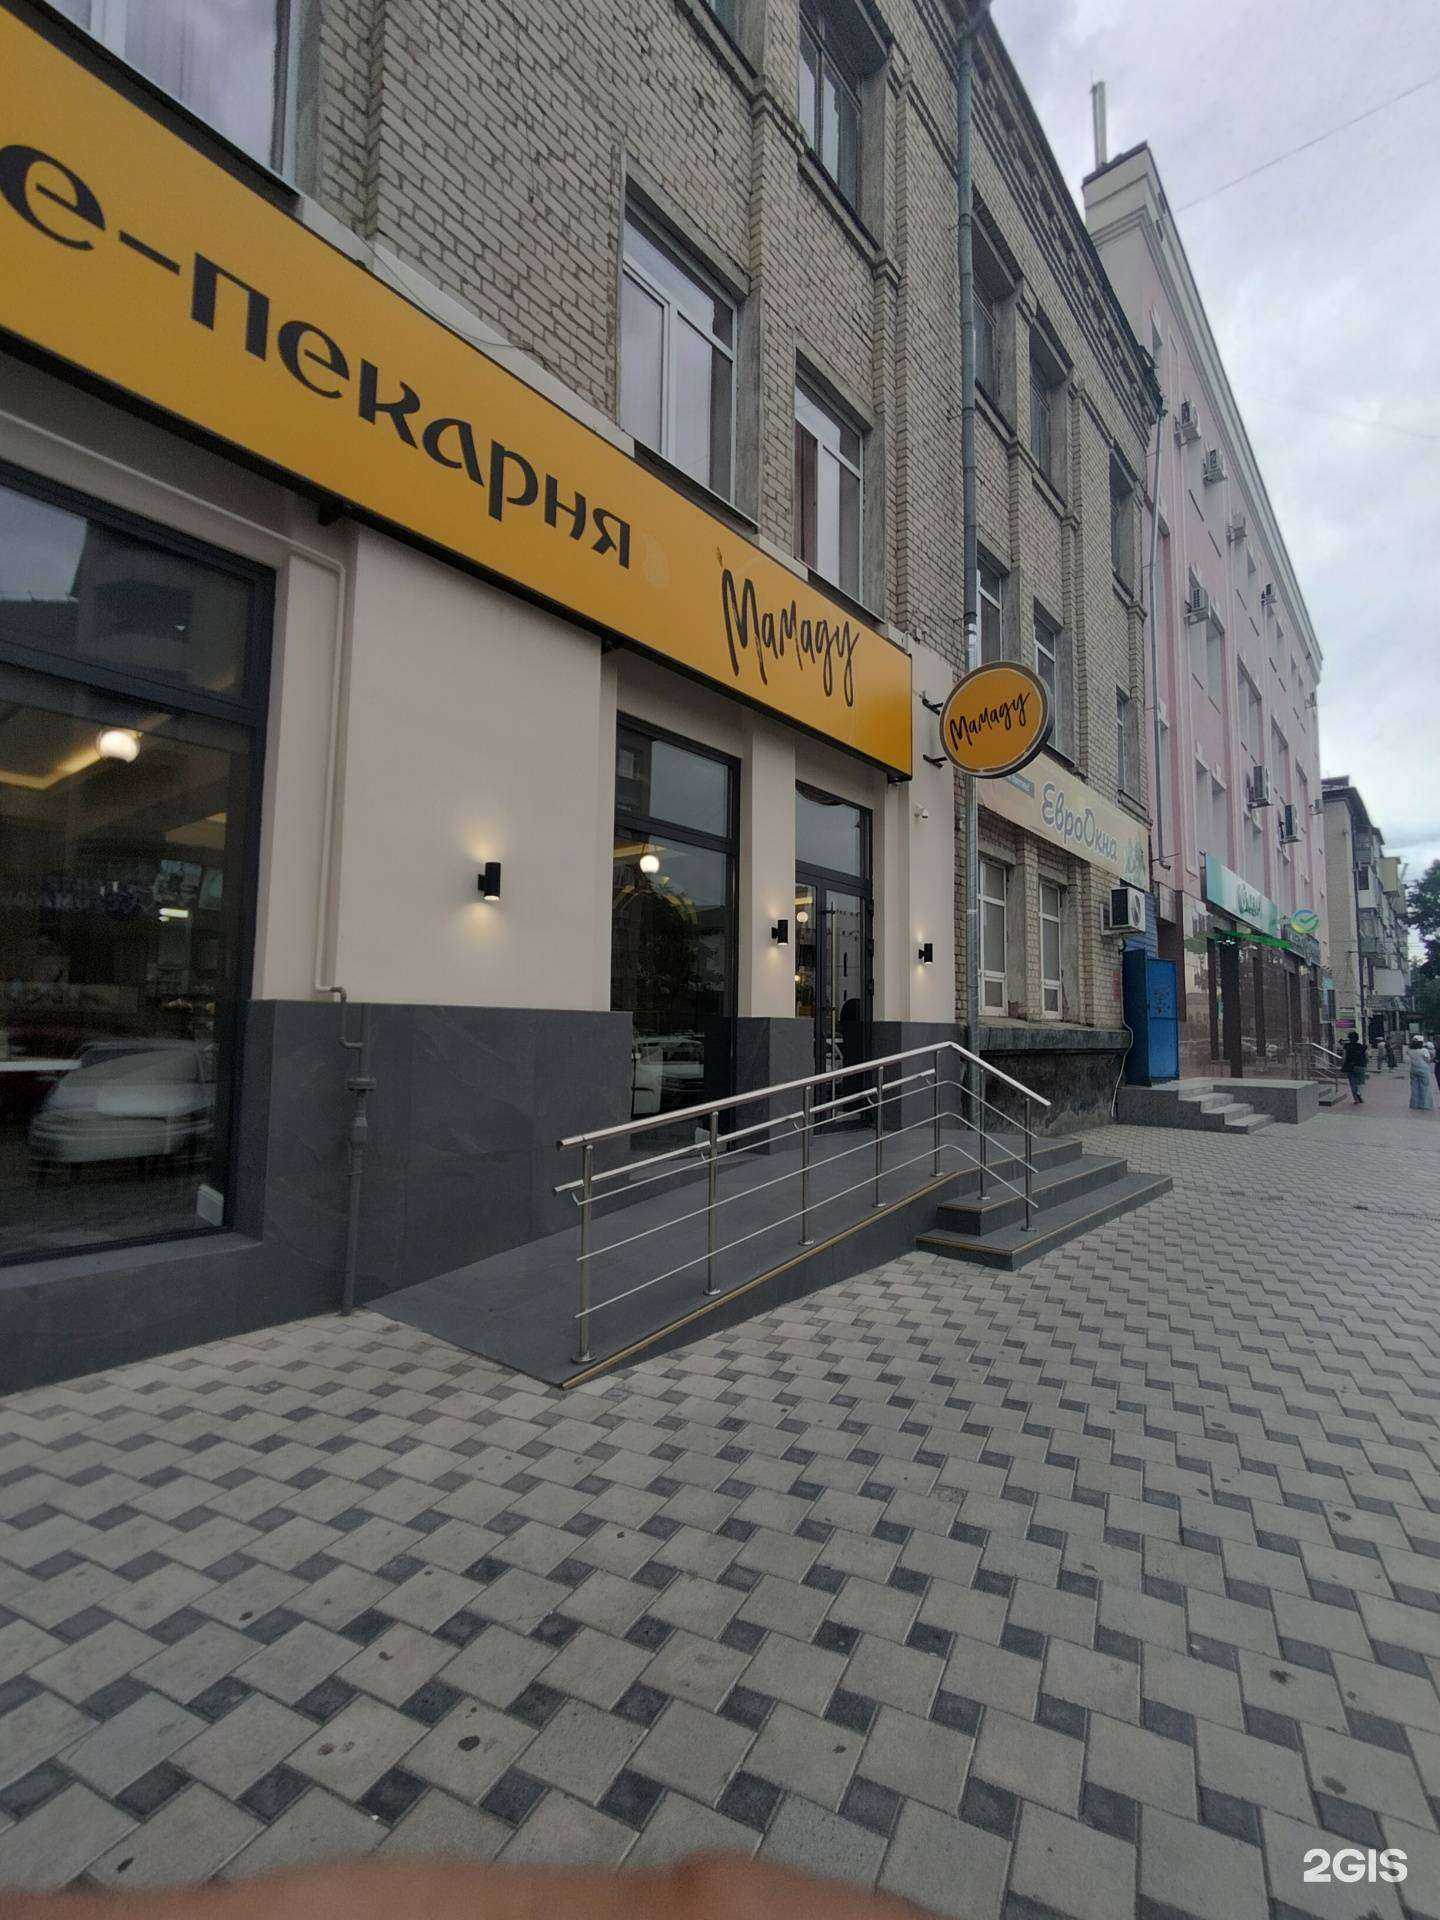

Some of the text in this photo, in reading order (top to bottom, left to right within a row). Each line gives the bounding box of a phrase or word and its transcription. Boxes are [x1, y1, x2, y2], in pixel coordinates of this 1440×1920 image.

[721, 567, 860, 707] Мамаду
[949, 692, 1031, 752] Мамаду
[1042, 783, 1118, 862] ЕвроОкна
